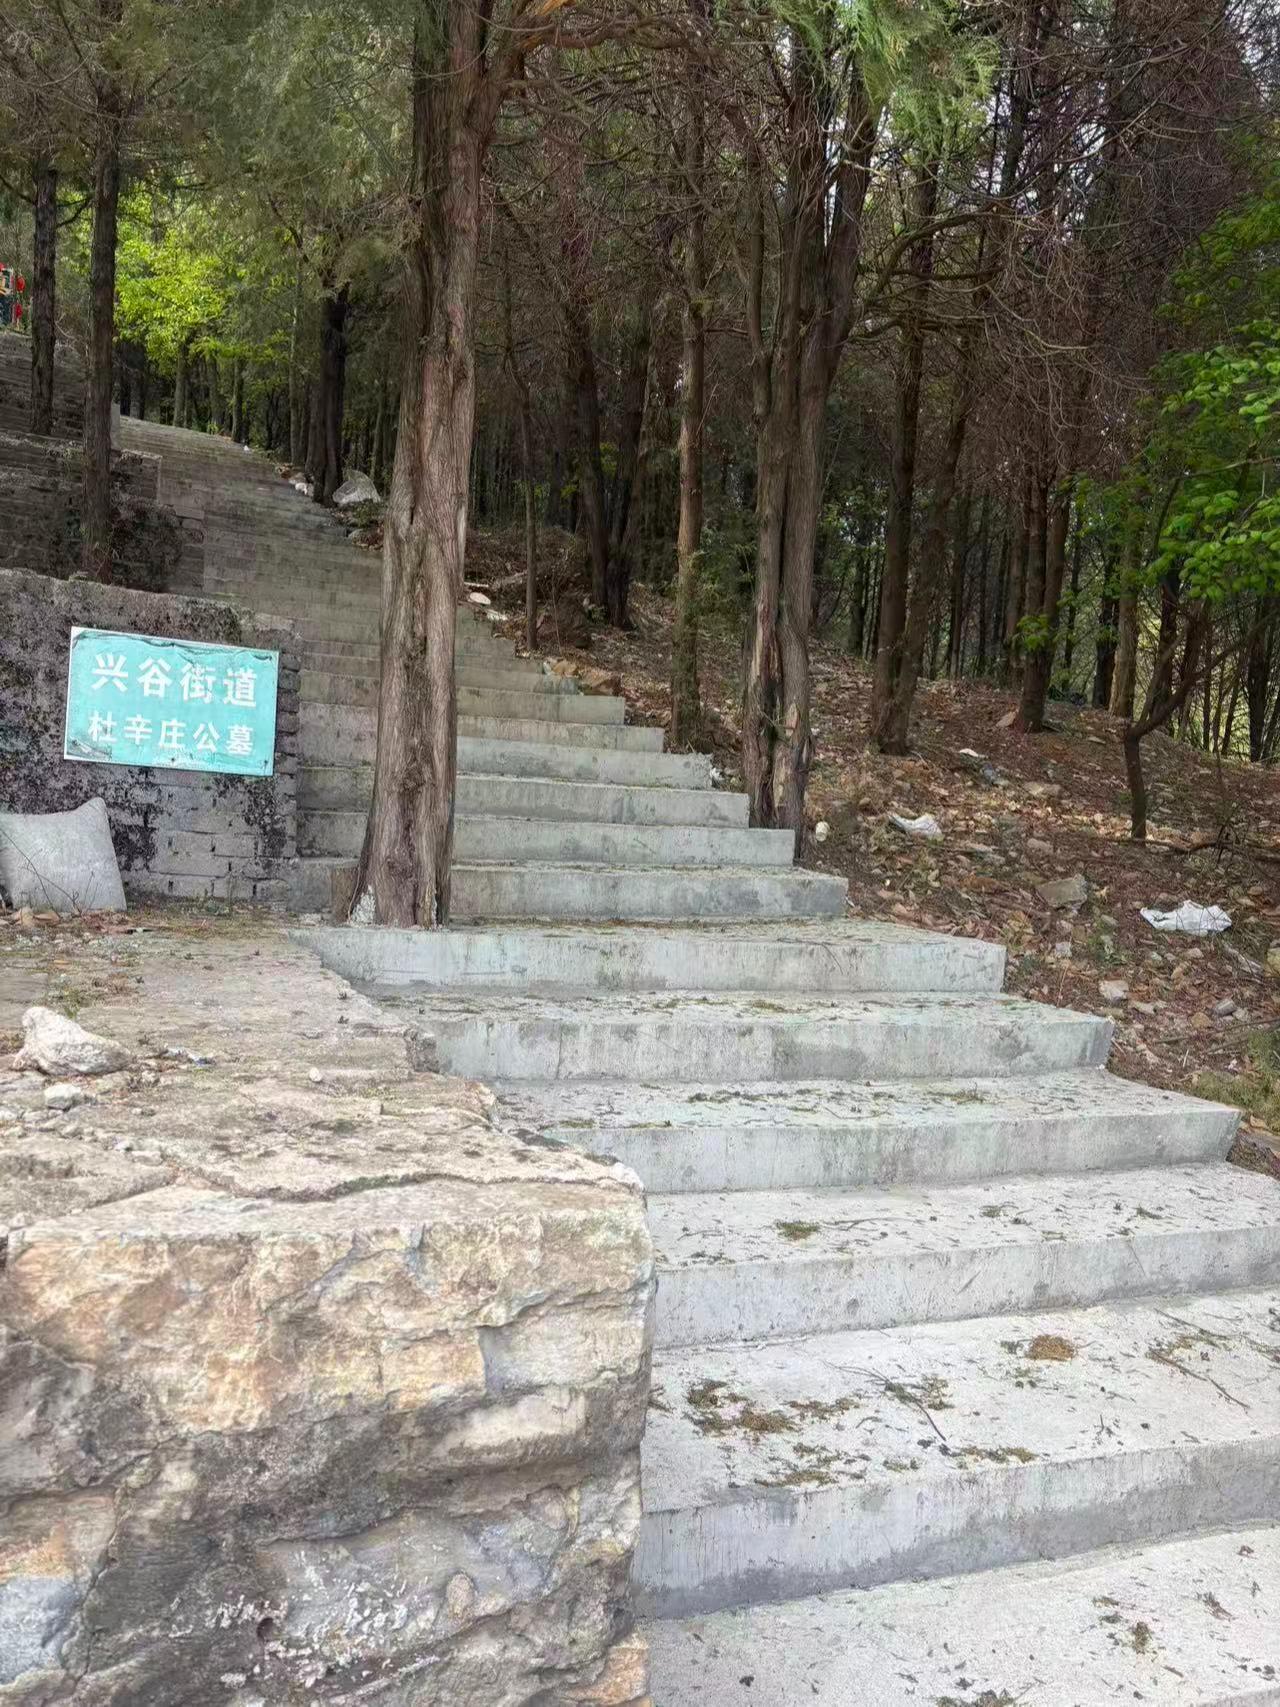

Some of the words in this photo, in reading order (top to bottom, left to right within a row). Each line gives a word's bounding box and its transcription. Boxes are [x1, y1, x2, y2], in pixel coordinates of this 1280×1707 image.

[91, 652, 257, 708] 兴谷街道
[88, 710, 254, 755] 杜辛庄公墓
